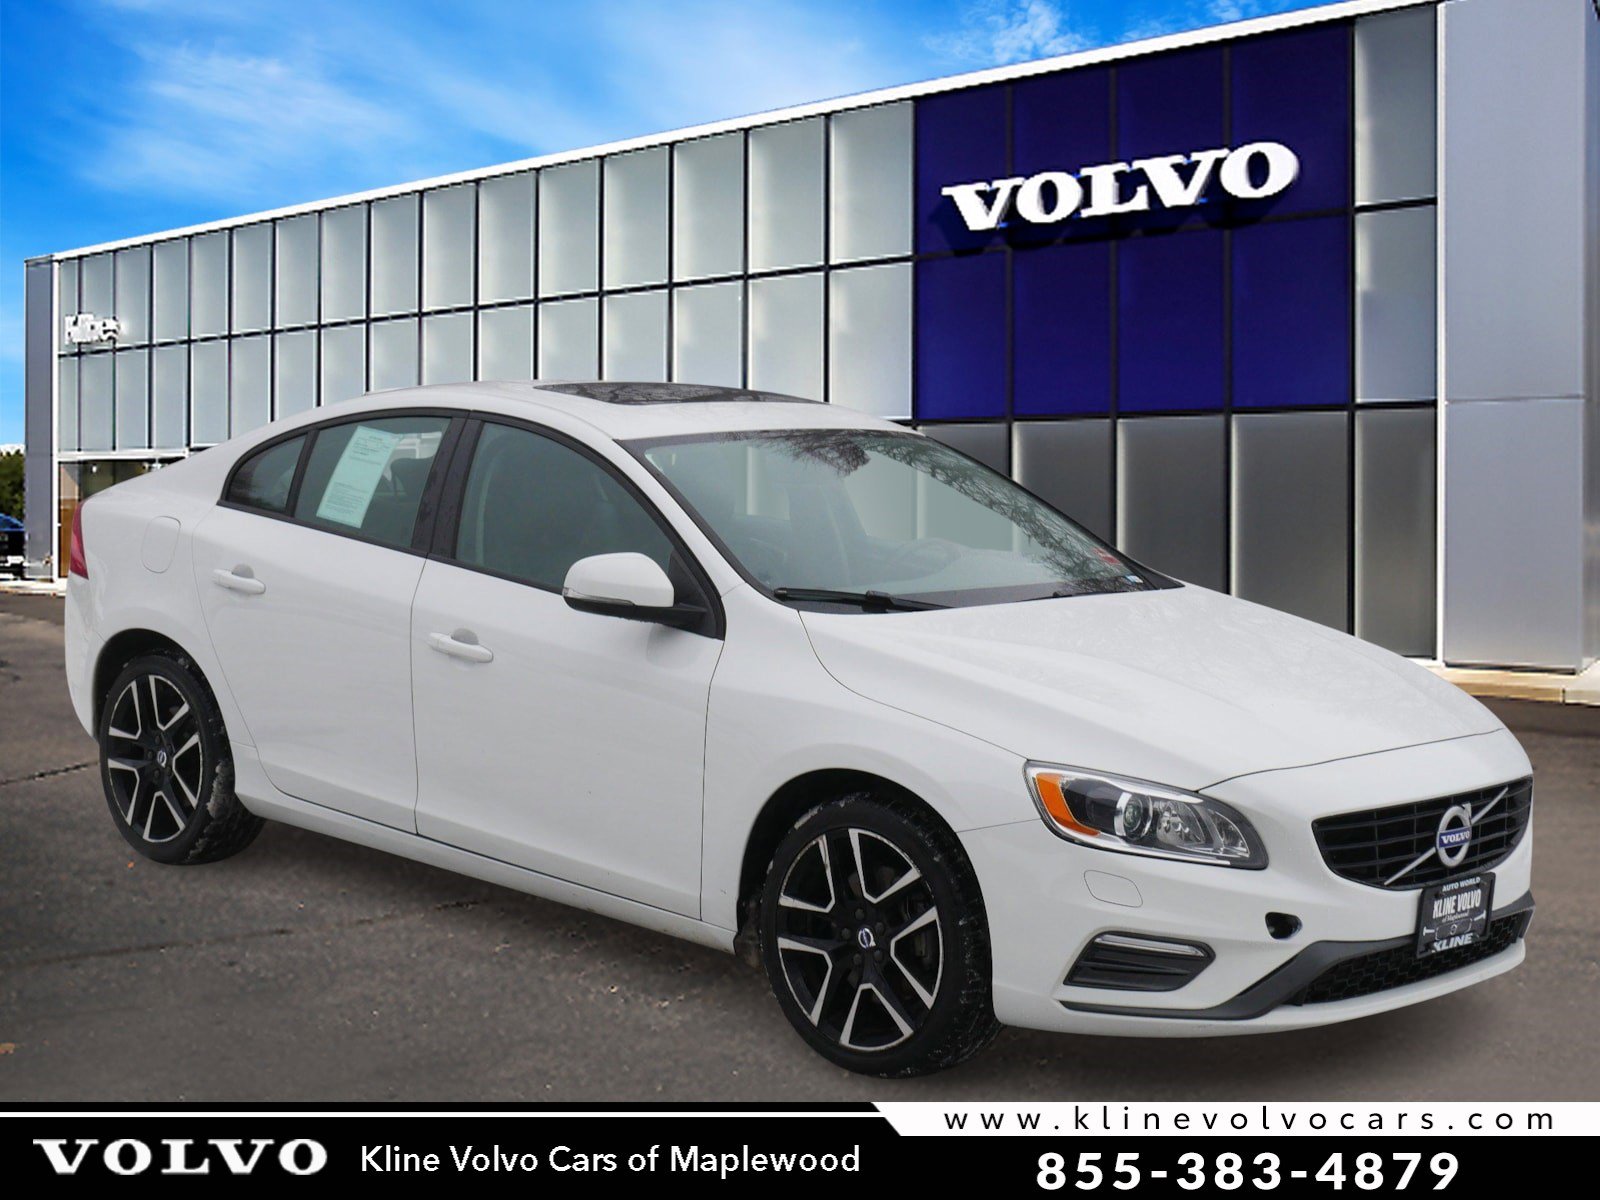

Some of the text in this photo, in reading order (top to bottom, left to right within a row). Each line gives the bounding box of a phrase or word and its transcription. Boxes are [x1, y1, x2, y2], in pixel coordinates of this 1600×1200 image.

[941, 142, 1300, 231] VOLVO
[1440, 830, 1470, 844] VOLVO
[1442, 877, 1481, 892] AUTO WORLD
[1433, 895, 1457, 919] KLINE
[1457, 889, 1482, 912] VOLVO
[1434, 932, 1473, 952] KLINE
